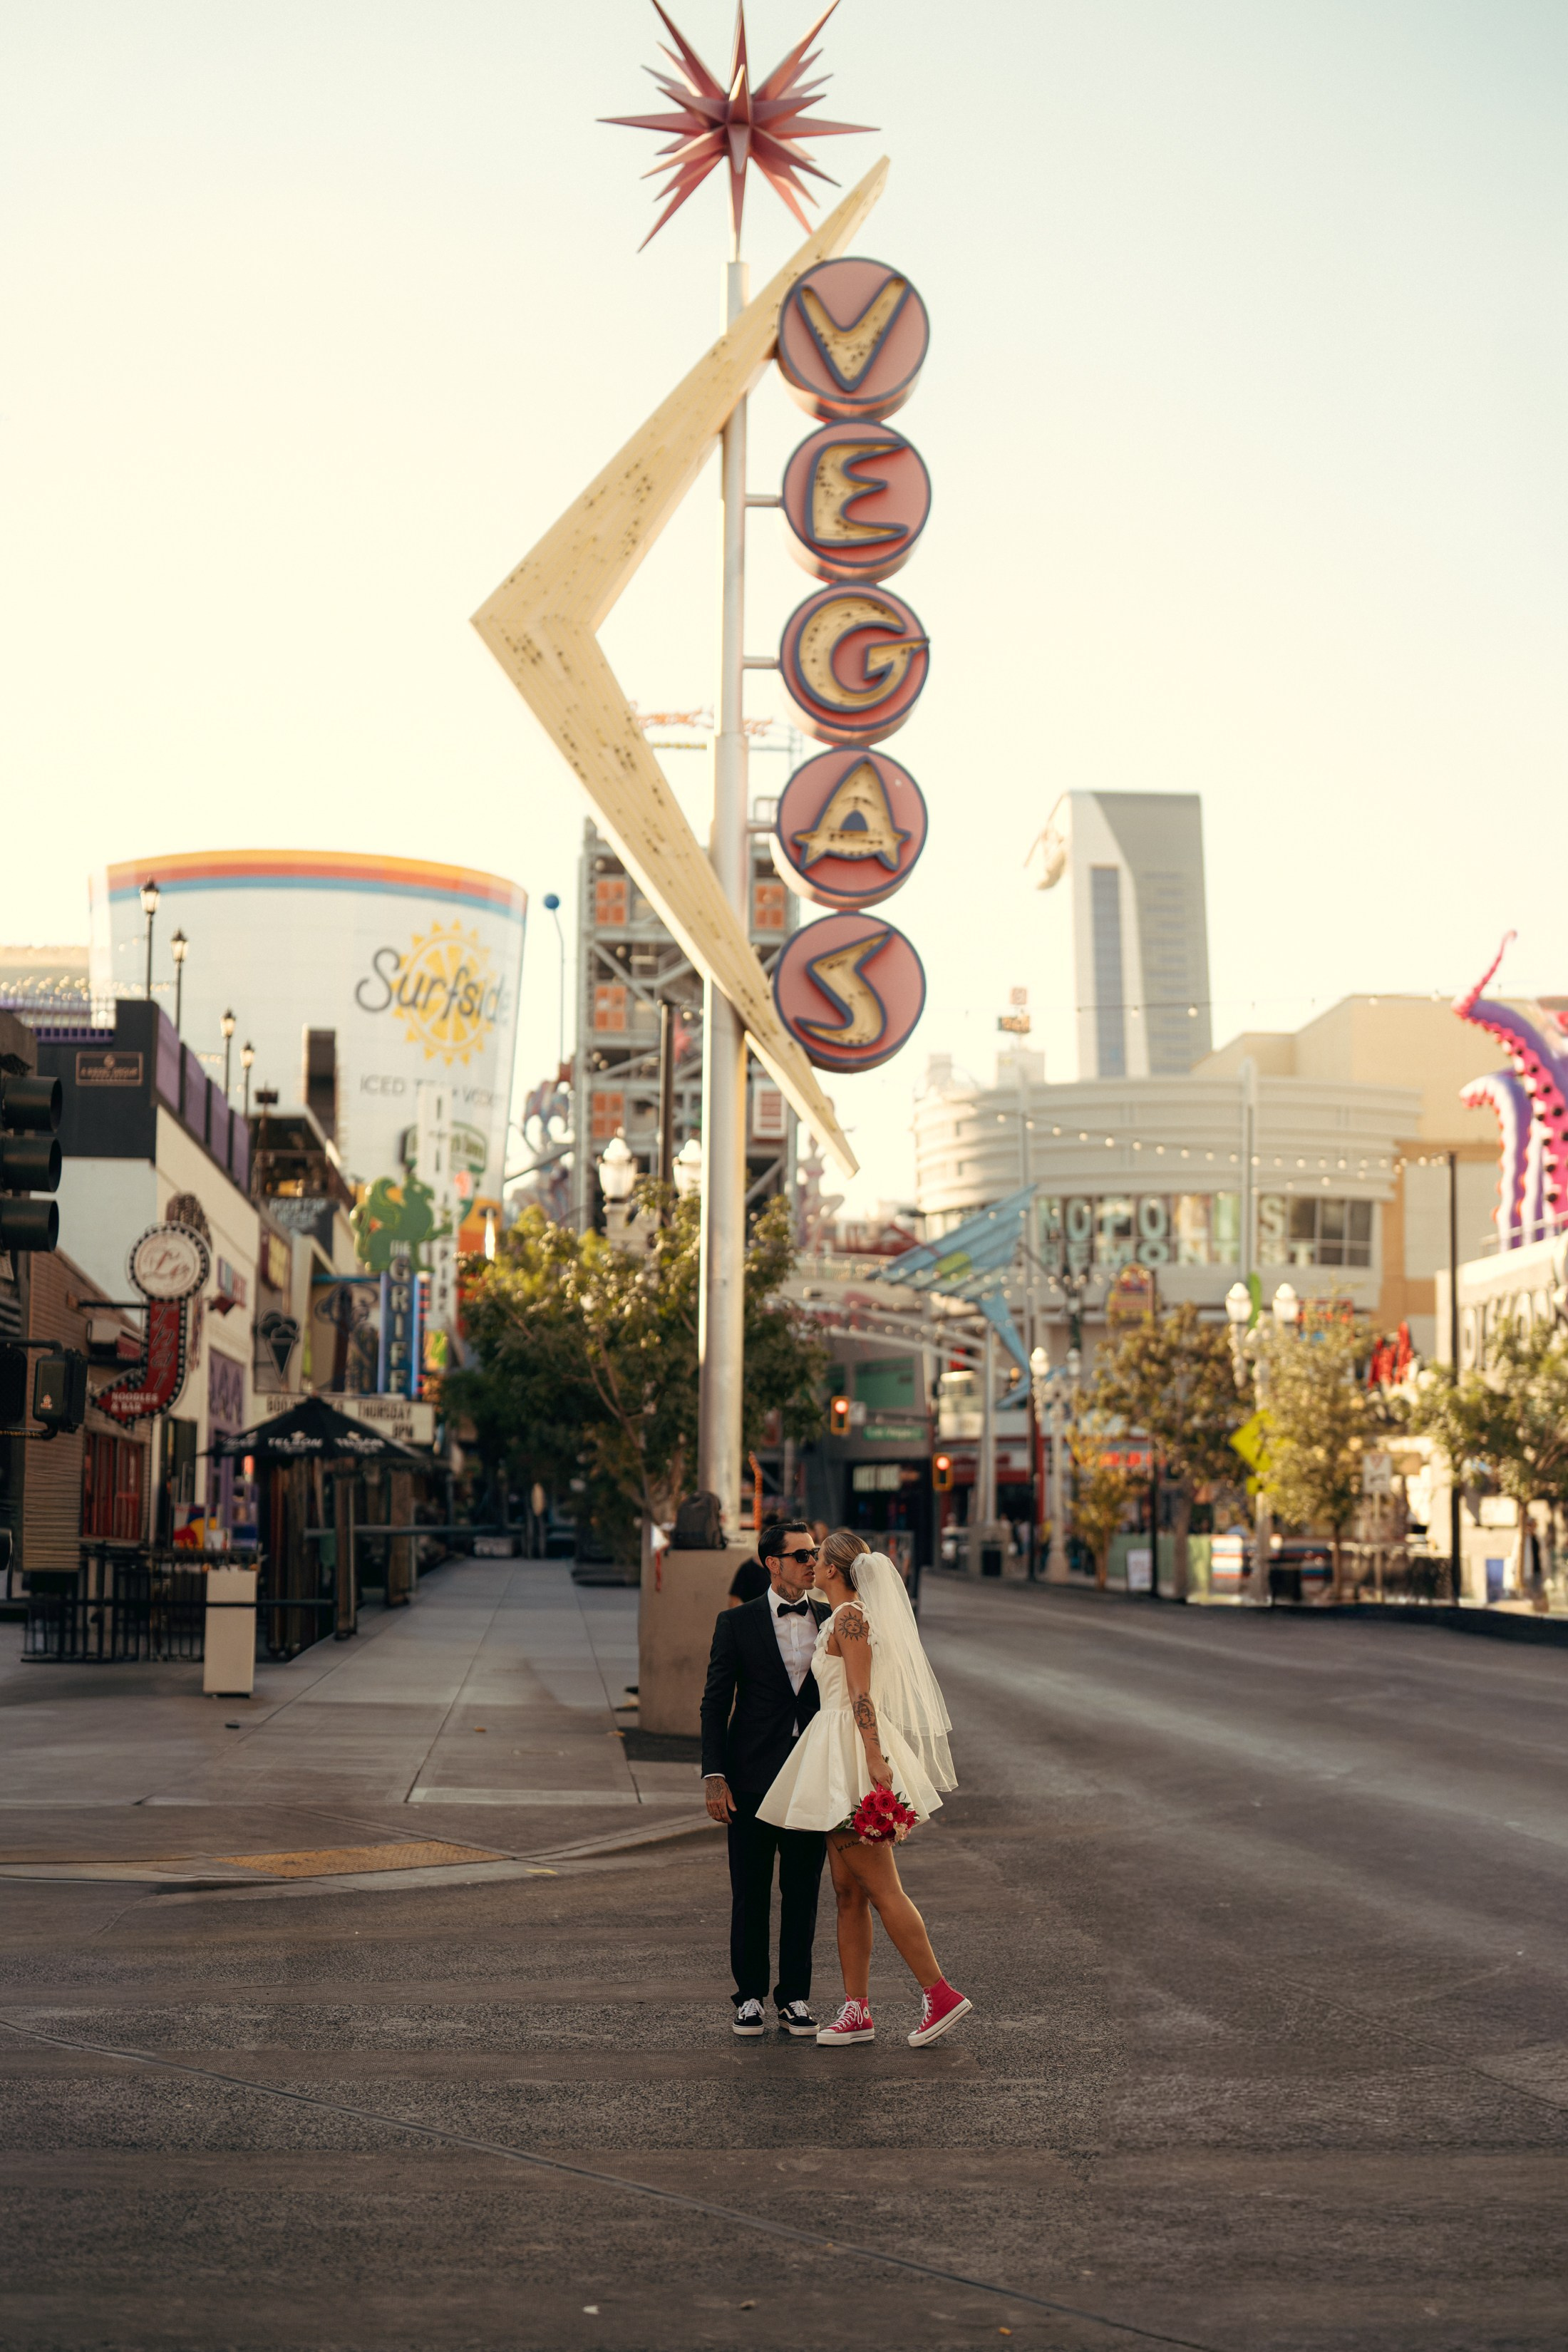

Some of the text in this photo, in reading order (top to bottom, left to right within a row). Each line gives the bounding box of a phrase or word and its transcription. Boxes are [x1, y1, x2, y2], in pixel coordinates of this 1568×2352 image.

[791, 272, 929, 1048] VEGAS
[360, 1074, 406, 1097] ICED
[111, 1391, 159, 1402] NOODLES
[120, 1402, 142, 1413] BAR
[357, 1400, 412, 1419] THURSDAY
